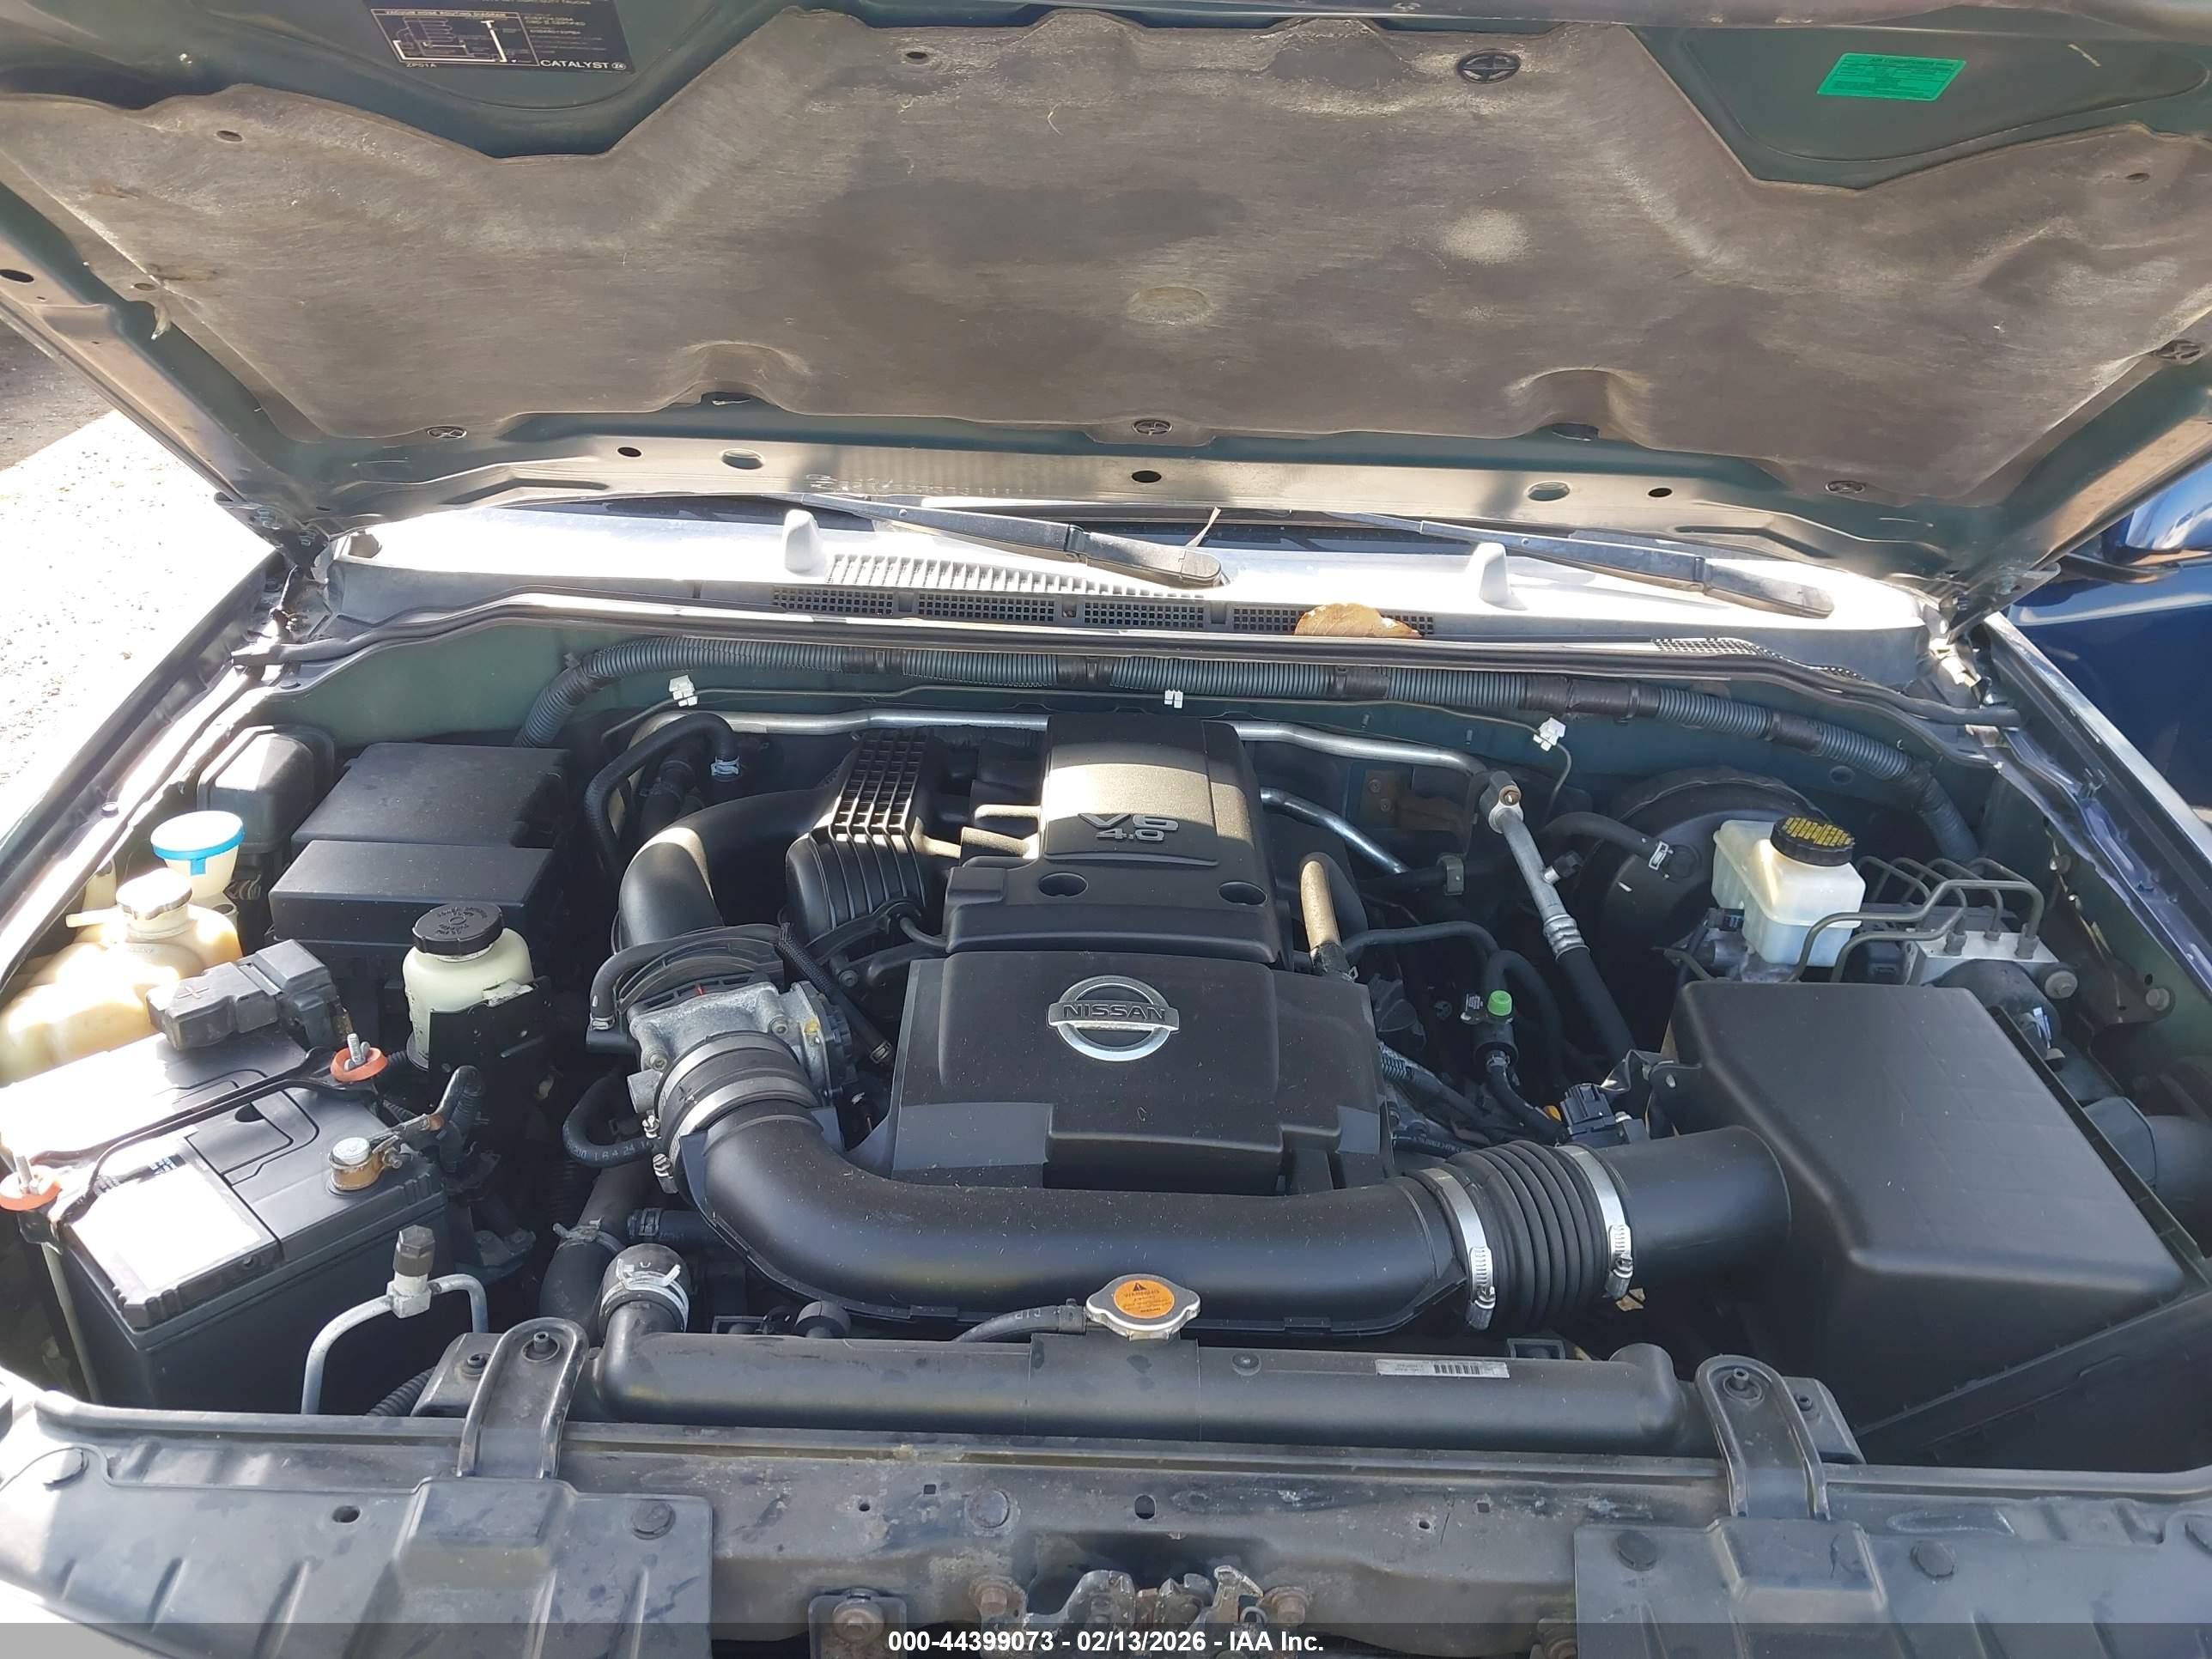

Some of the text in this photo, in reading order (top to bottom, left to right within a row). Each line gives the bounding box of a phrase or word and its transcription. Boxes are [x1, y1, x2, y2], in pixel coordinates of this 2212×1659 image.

[540, 60, 609, 69] CATALYST
[1096, 828, 1165, 842] 4.0
[1063, 1004, 1166, 1023] NISSAN
